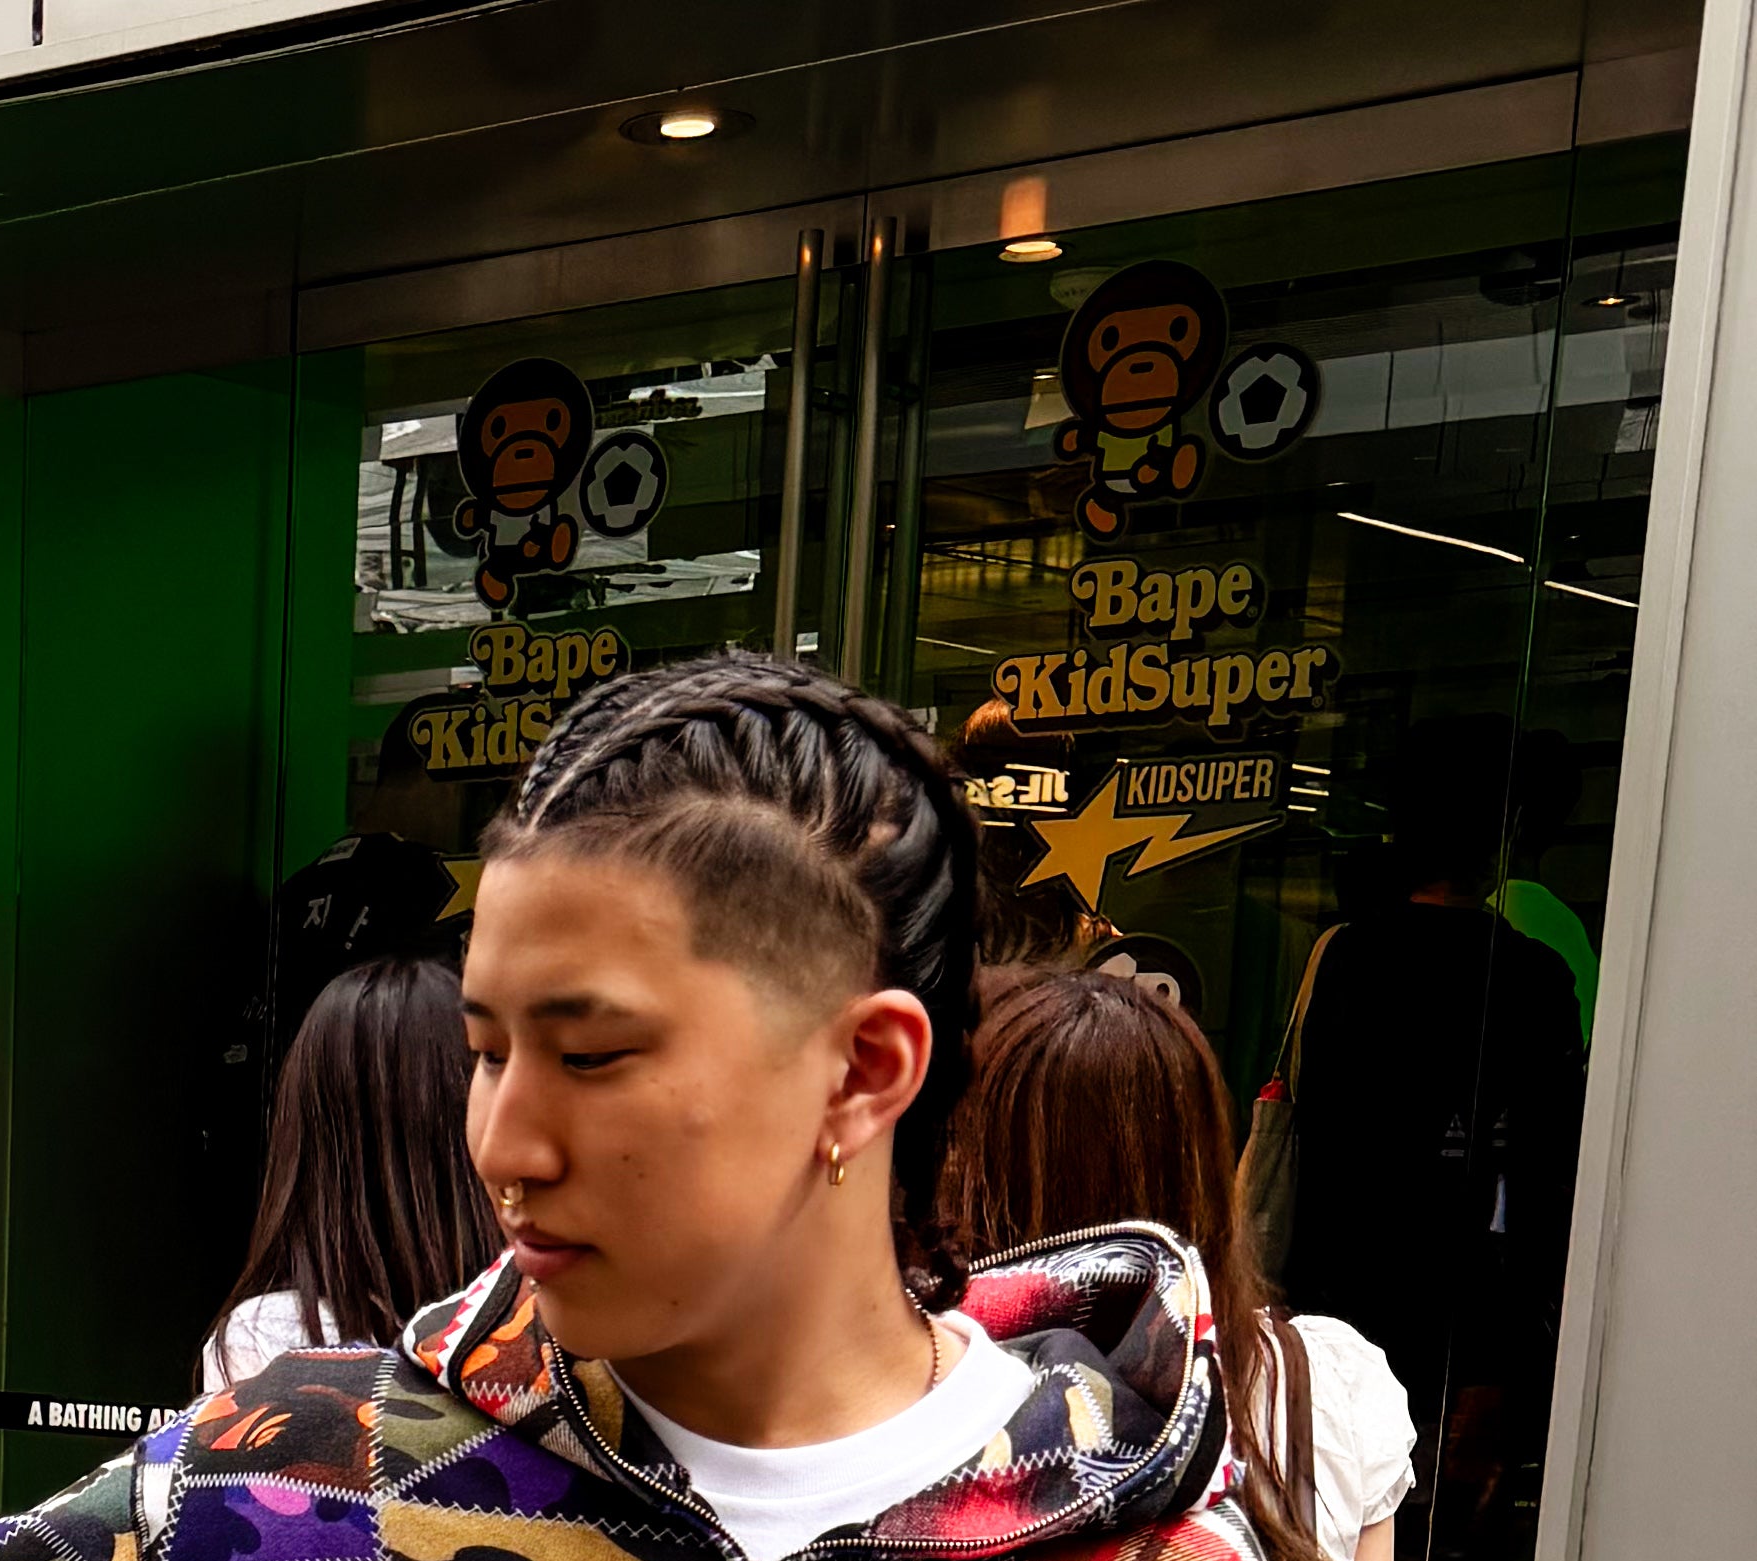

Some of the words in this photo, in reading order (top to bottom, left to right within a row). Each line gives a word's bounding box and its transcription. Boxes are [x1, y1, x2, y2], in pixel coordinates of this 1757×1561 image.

[472, 625, 618, 699] Bape
[1126, 758, 1275, 806] KIDSUPER
[27, 1400, 44, 1426] A
[48, 1401, 143, 1432] BATHING
[147, 1408, 188, 1433] AP
